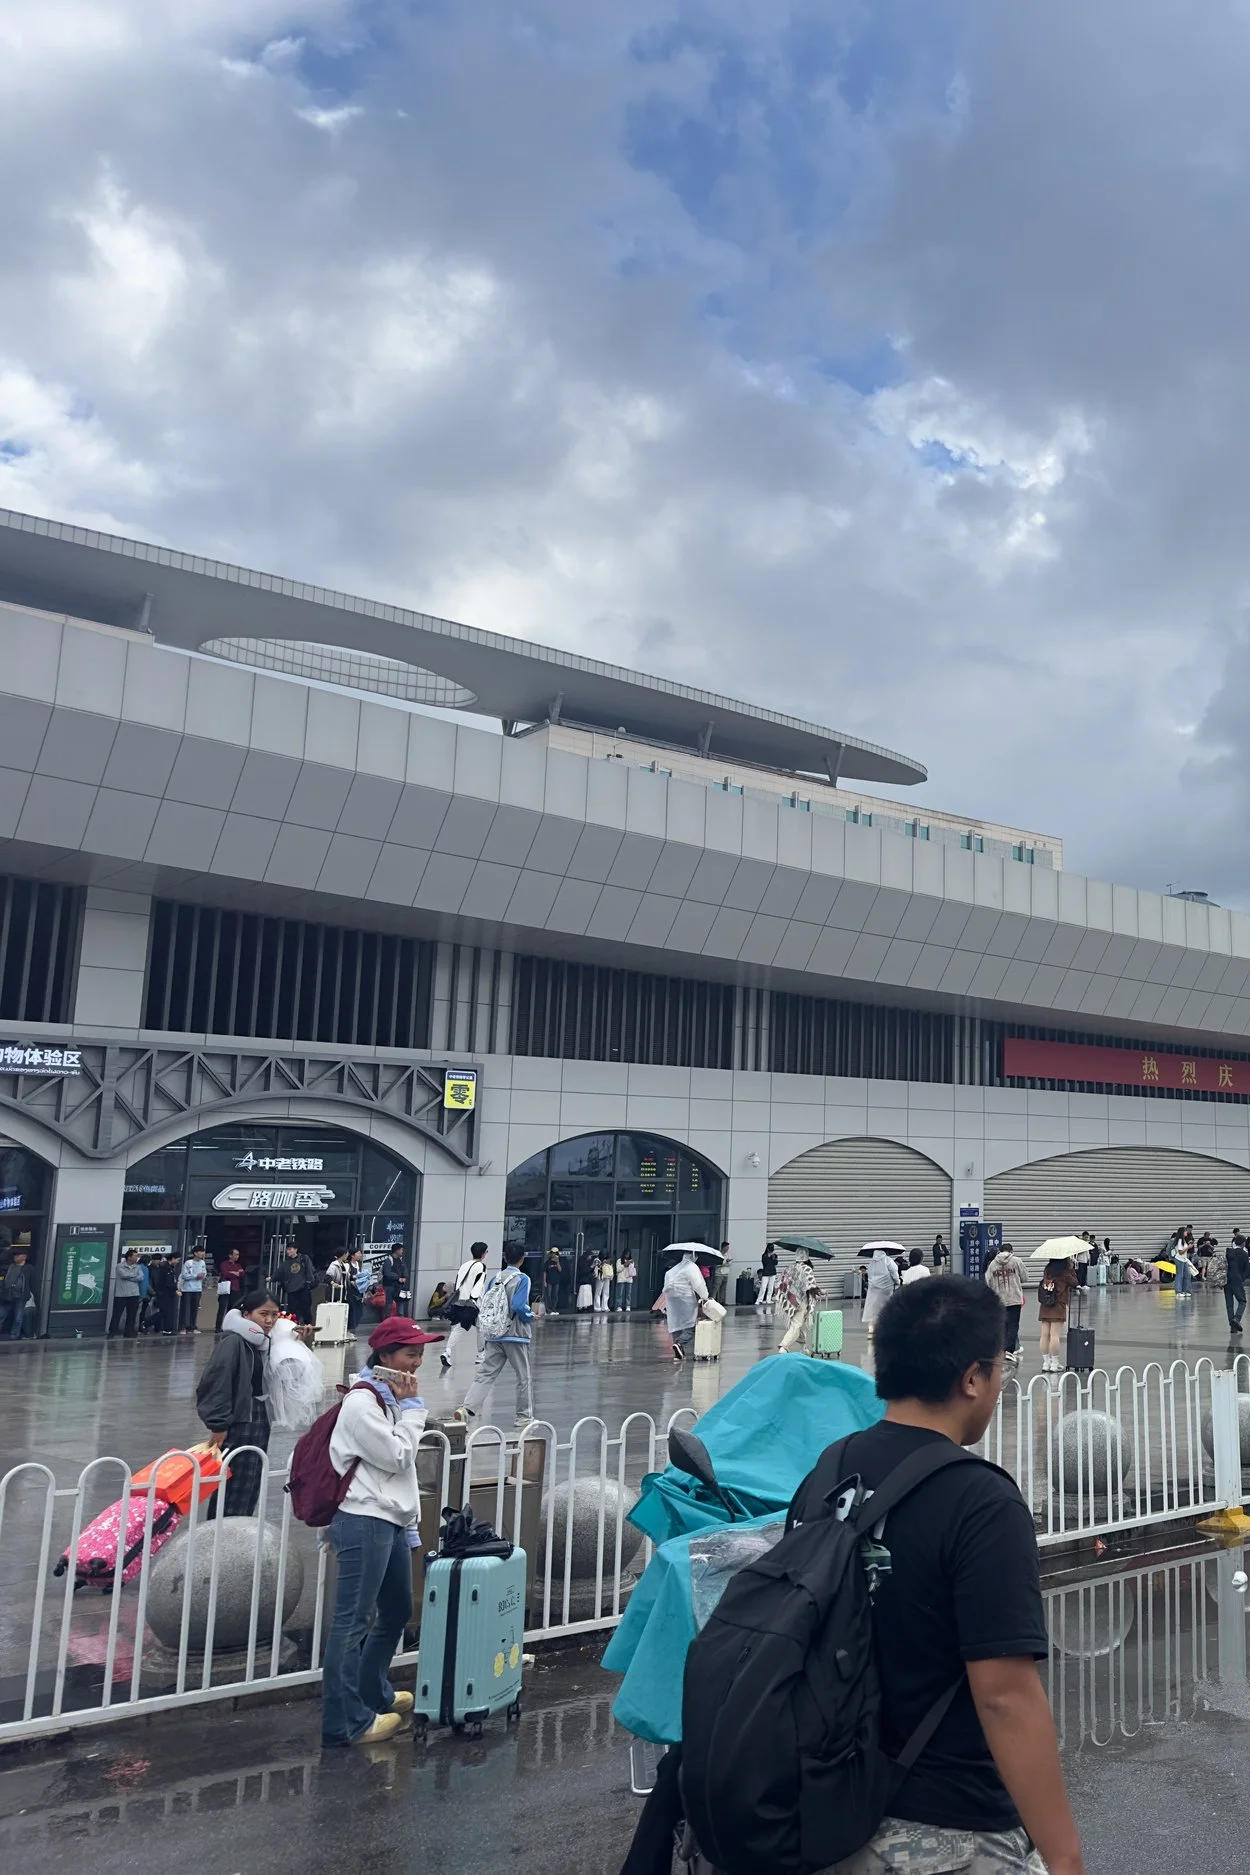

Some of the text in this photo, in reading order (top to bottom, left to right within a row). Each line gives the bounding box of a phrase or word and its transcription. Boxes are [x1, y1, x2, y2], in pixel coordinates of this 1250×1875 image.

[450, 1083, 470, 1104] 零
[258, 1157, 324, 1171] 中老铁路
[228, 1190, 323, 1208] 一路咖香
